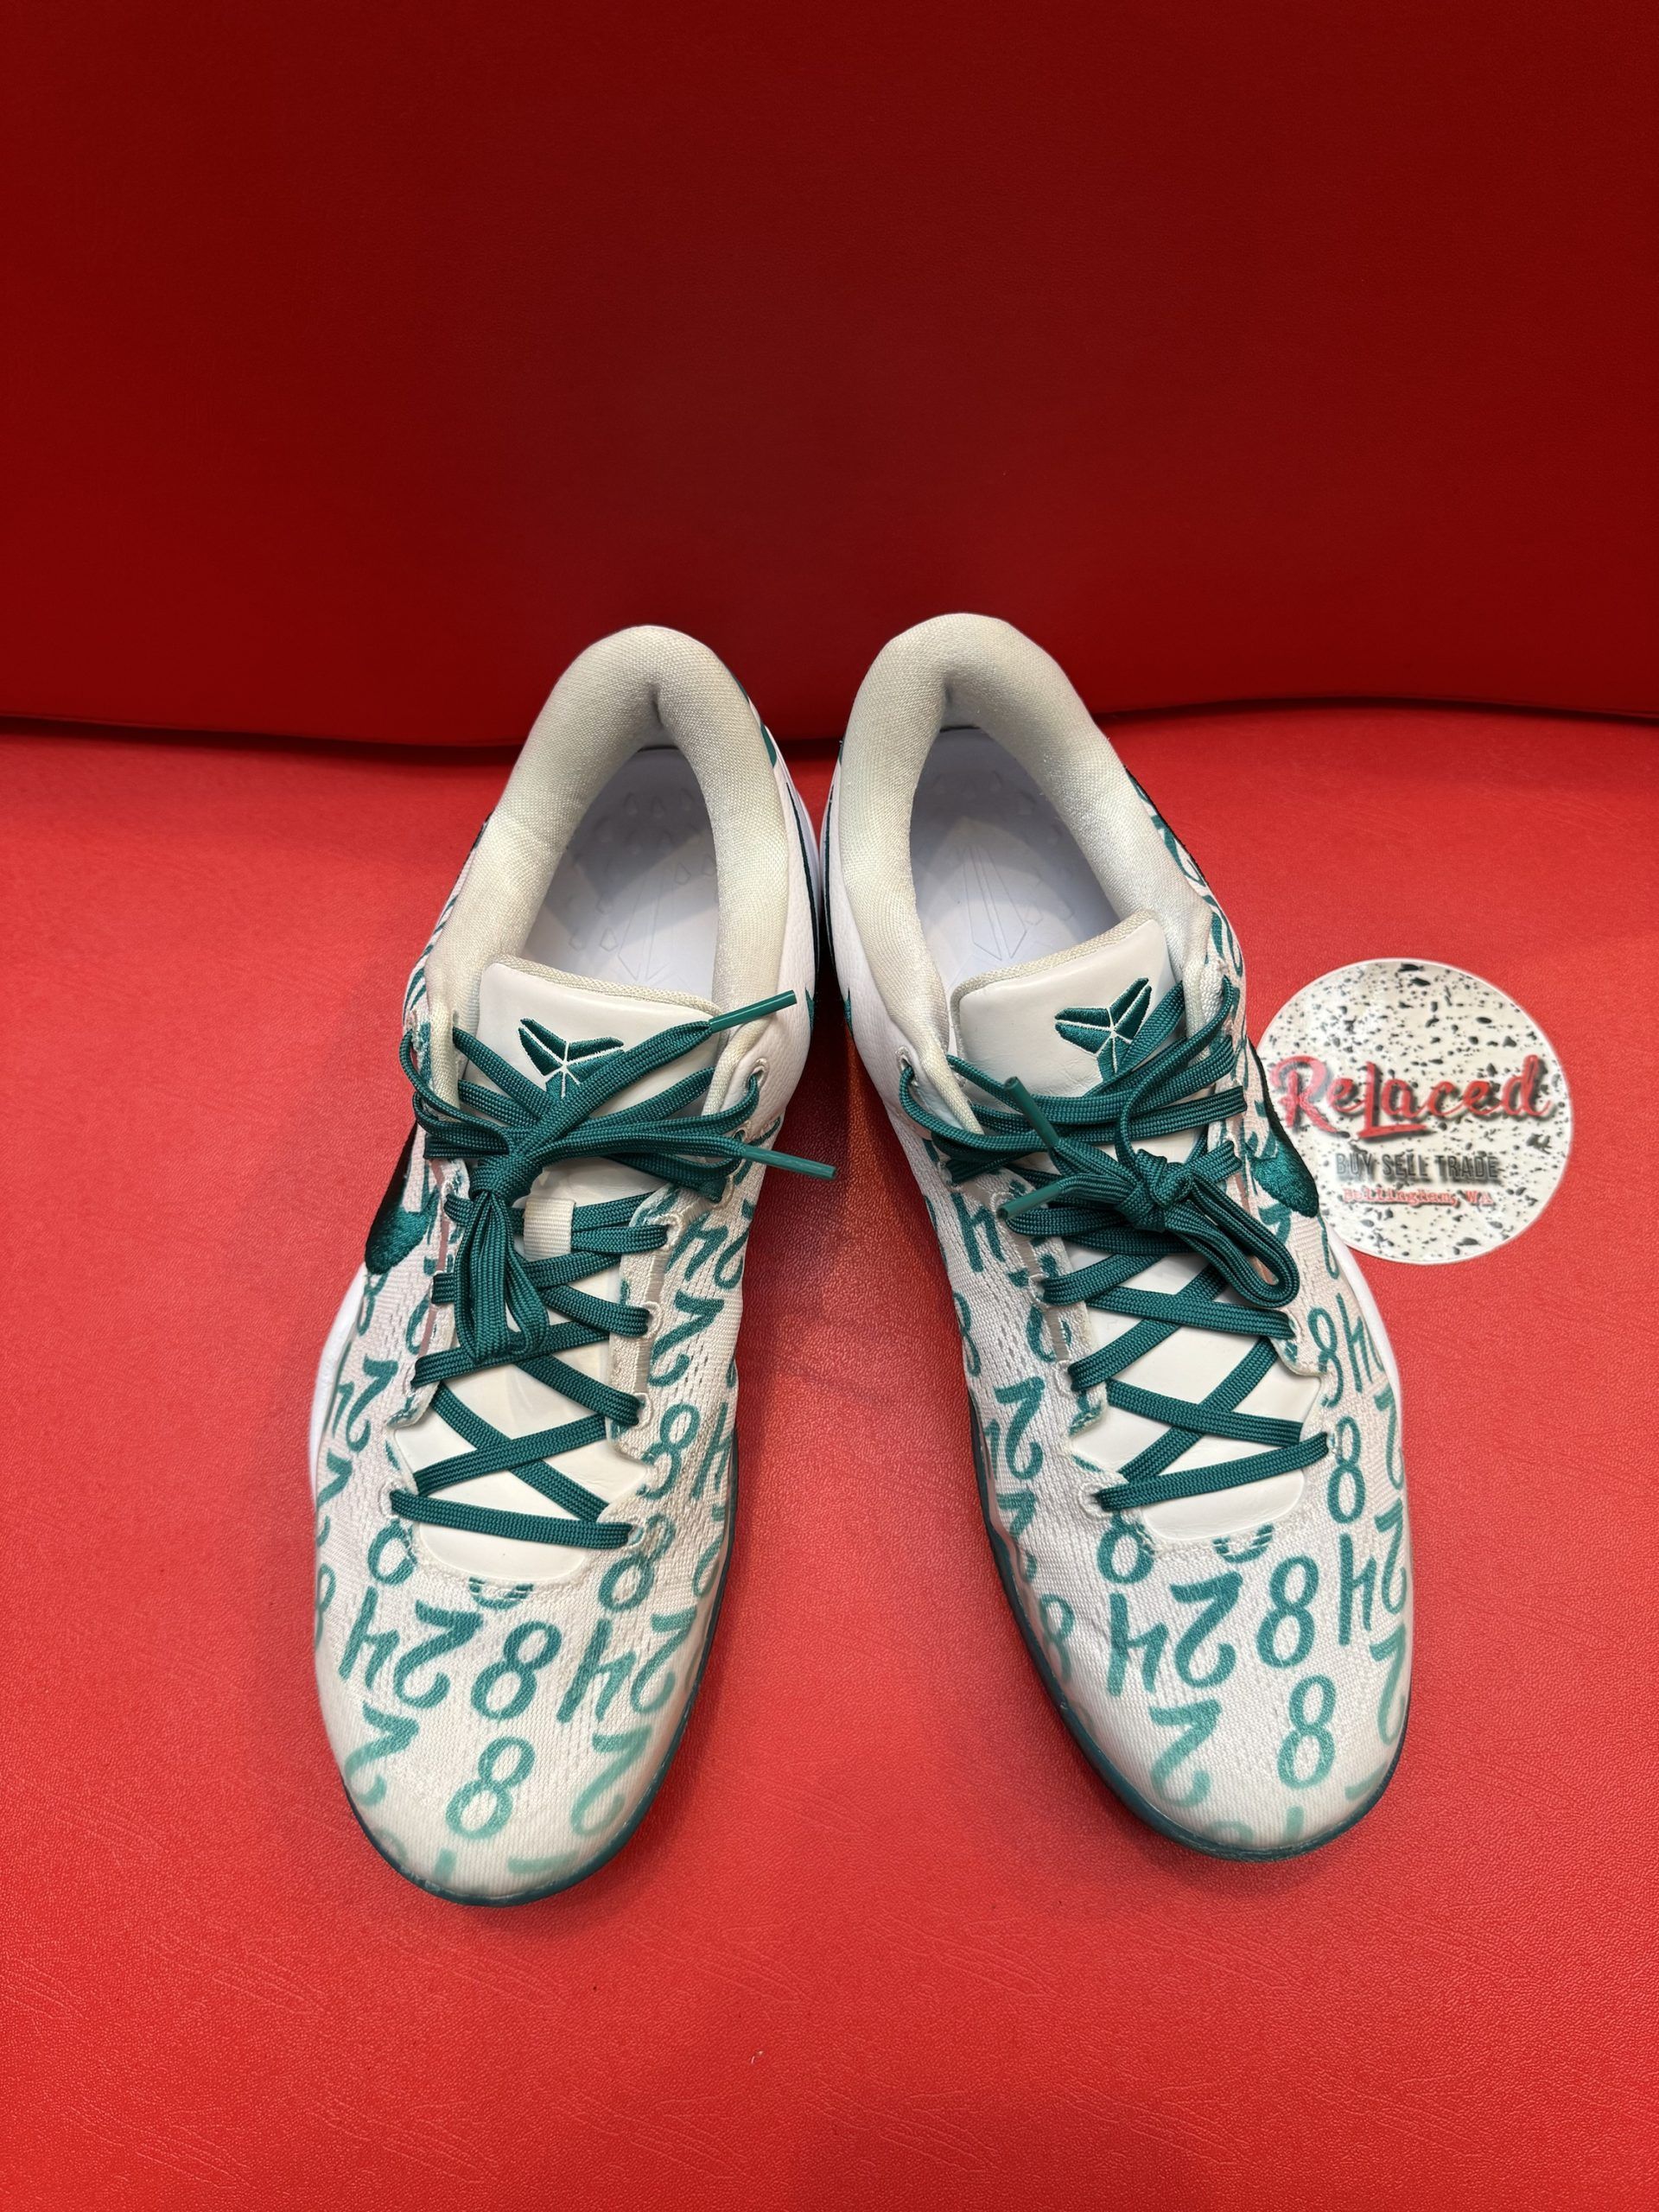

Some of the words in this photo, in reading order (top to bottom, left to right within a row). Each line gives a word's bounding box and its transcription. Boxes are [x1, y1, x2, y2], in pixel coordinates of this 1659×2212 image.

[1335, 1153, 1374, 1176] BUY
[1382, 1153, 1428, 1178] SELL
[1434, 1154, 1499, 1179] TRADE
[1343, 1187, 1458, 1206] Bellingham,
[1465, 1190, 1495, 1205] WA
[1326, 1415, 1367, 1525] 8
[1255, 1554, 1320, 1669] 8
[471, 1620, 563, 1722] 8
[1277, 1673, 1338, 1790] 8
[445, 1735, 537, 1840] 8
